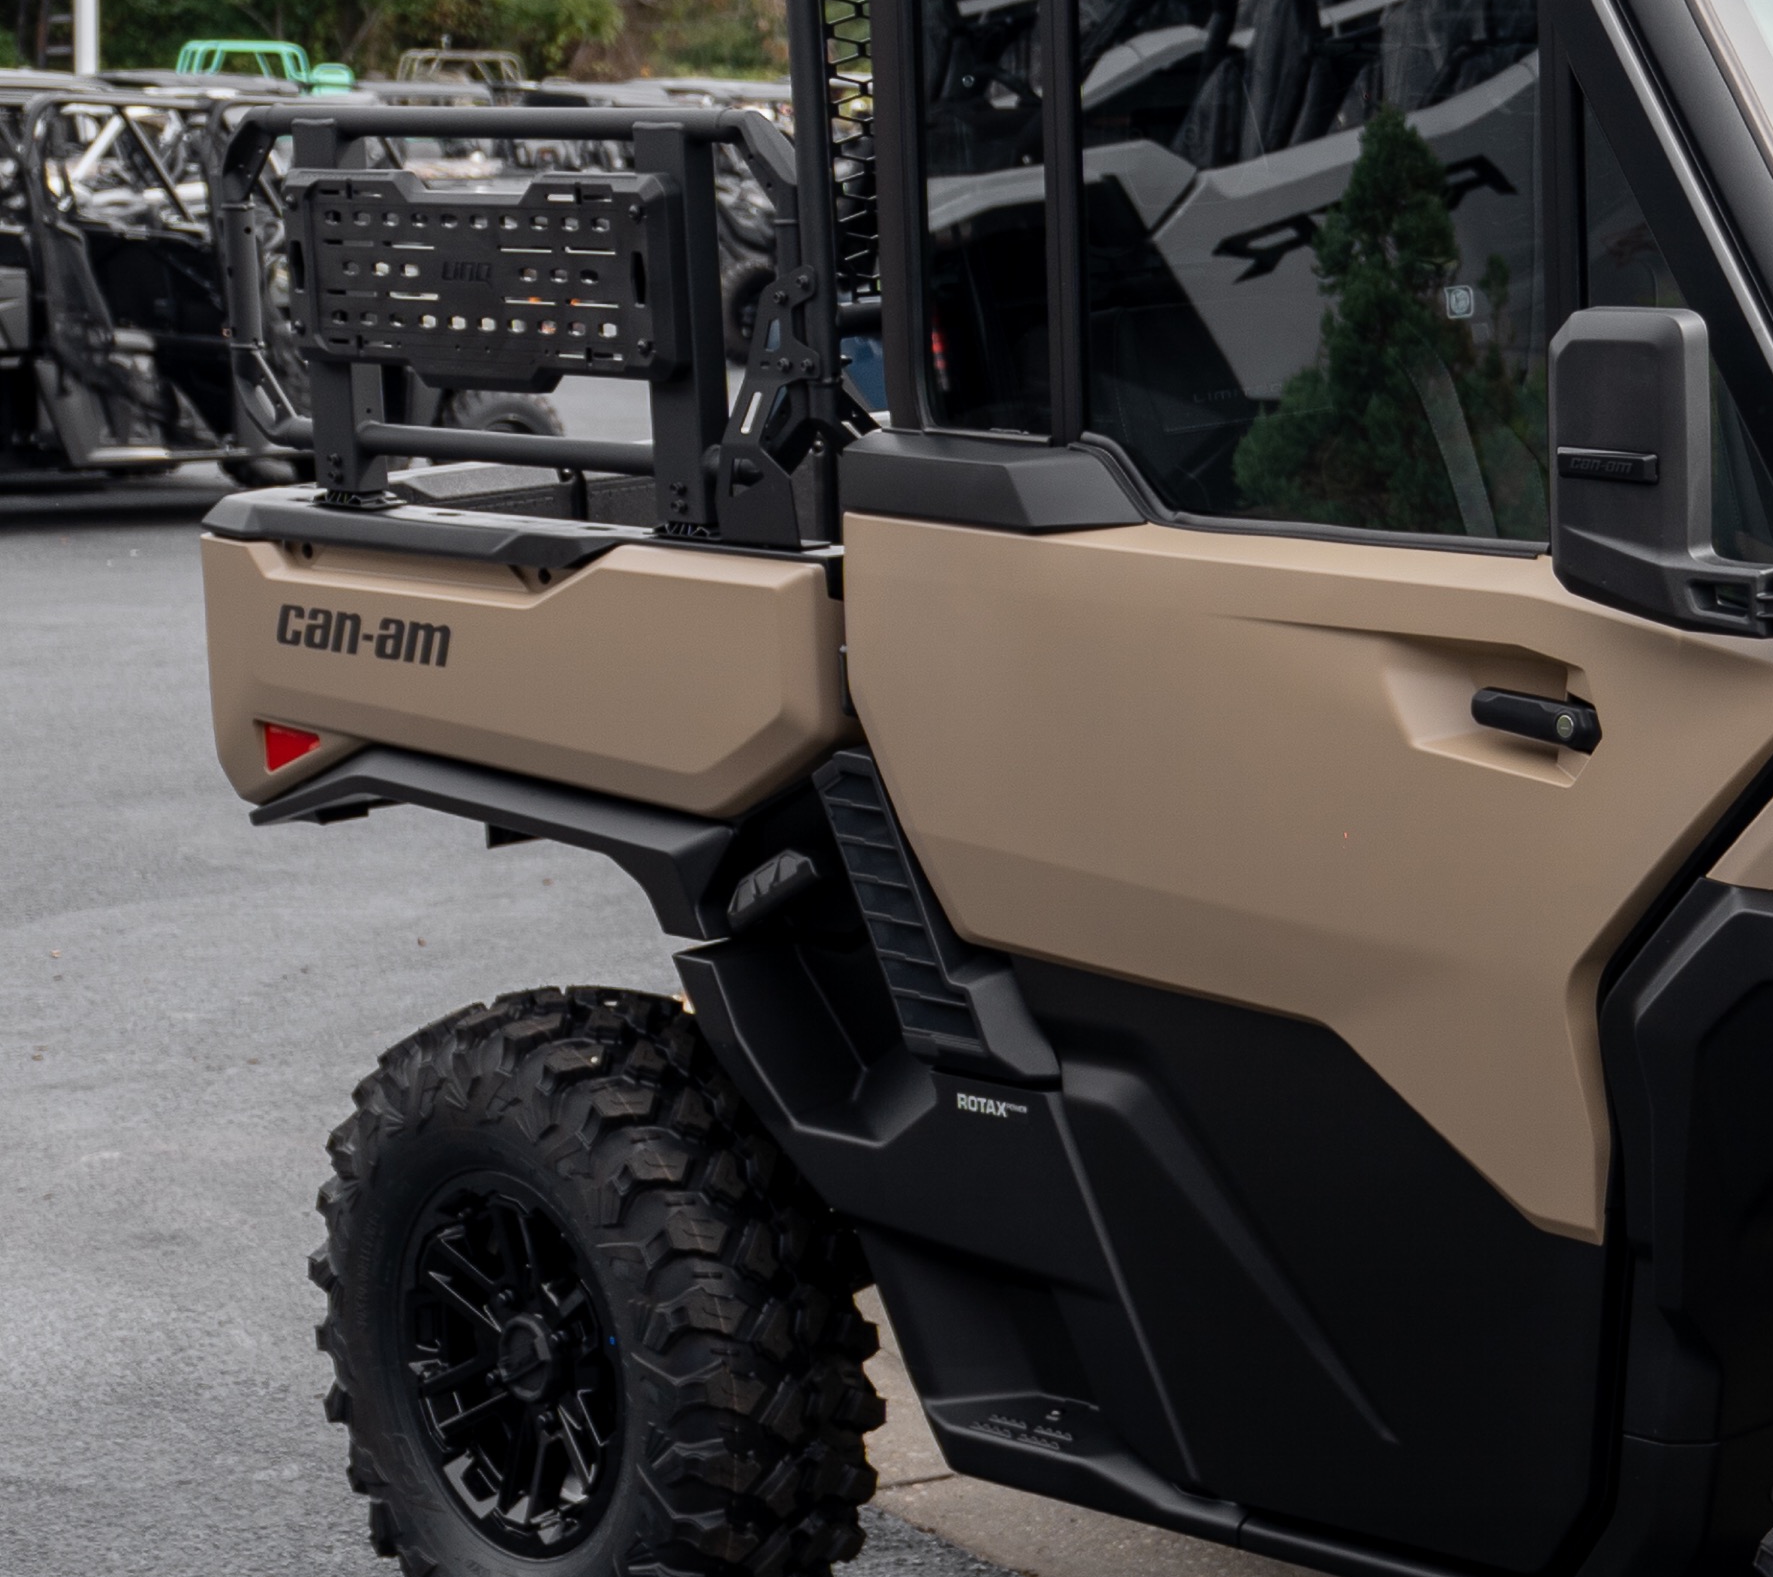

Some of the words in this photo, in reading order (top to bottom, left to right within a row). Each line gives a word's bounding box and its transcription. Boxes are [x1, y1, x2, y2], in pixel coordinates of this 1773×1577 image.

[1569, 457, 1633, 474] can-am
[276, 603, 452, 668] can-am
[957, 1092, 1007, 1118] ROTAX
